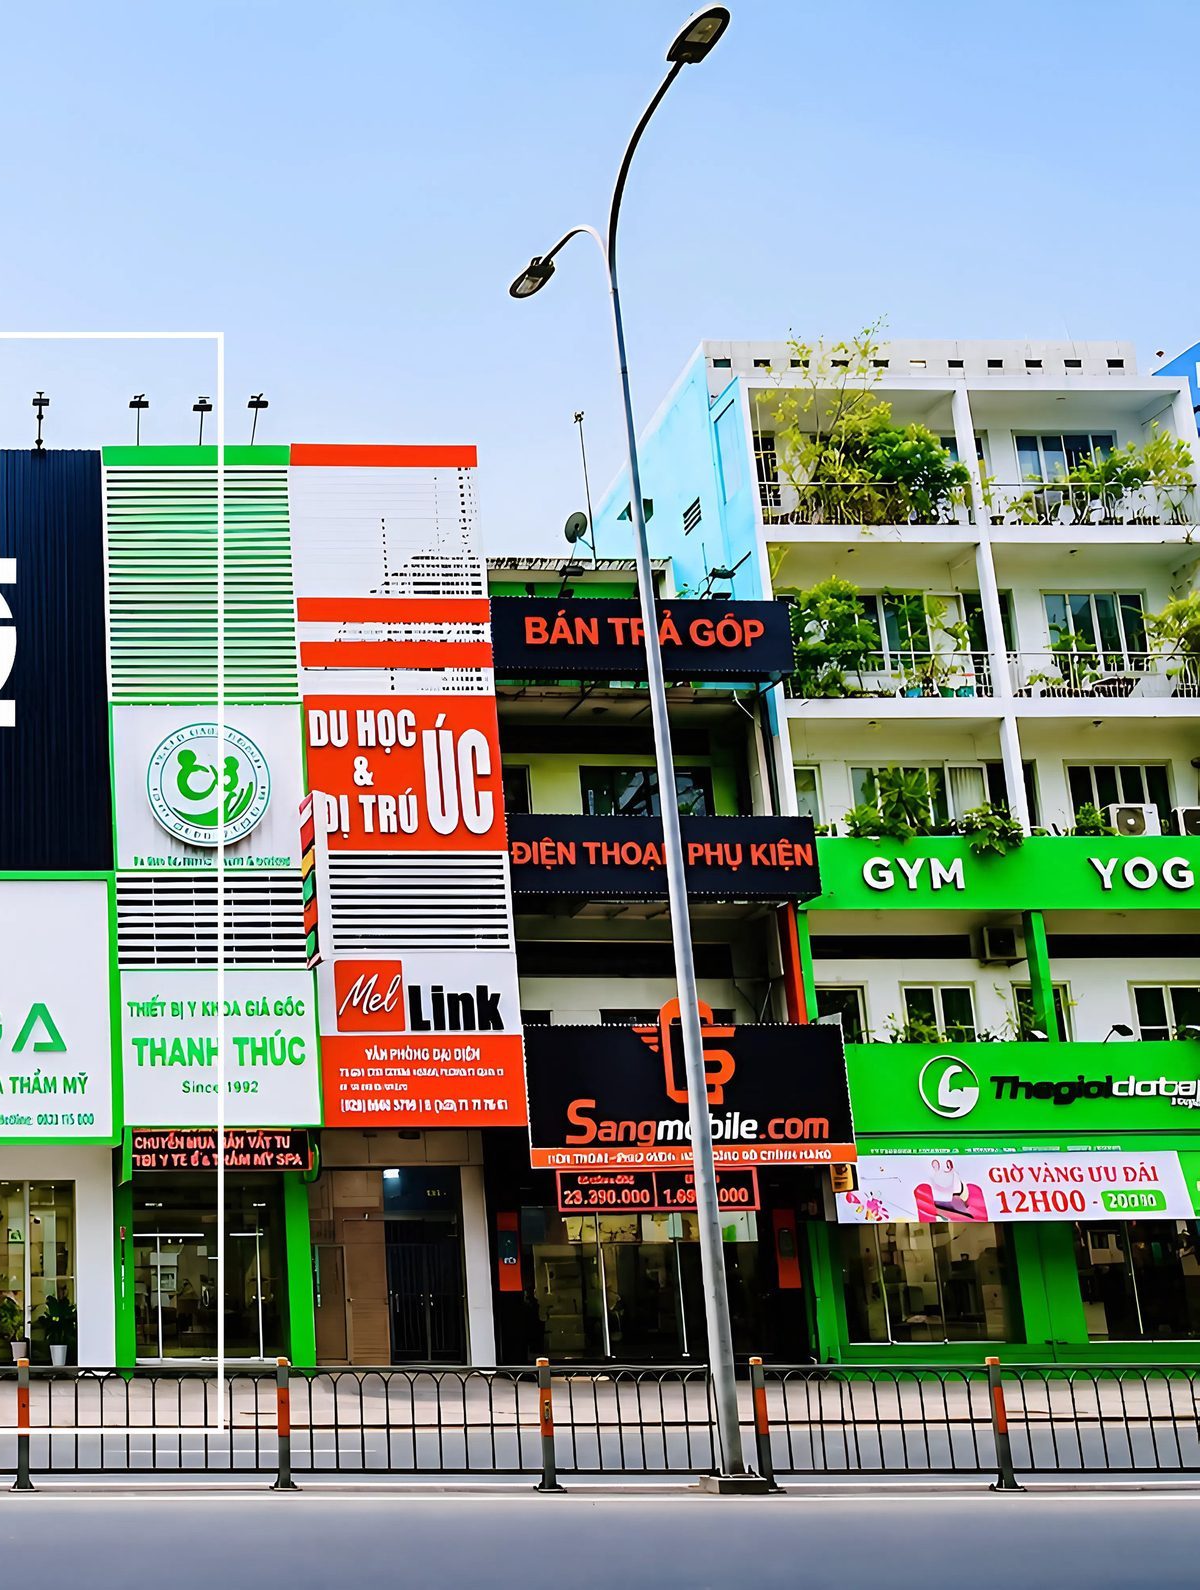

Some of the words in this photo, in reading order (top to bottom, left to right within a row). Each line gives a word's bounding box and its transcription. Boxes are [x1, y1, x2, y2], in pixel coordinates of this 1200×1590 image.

[524, 609, 599, 645] BÁN
[689, 612, 765, 648] GÓP
[308, 709, 349, 748] DU
[356, 708, 417, 755] HỌC
[352, 755, 375, 787] &
[421, 713, 495, 836] ÚC
[358, 787, 419, 835] TRÚ
[510, 836, 576, 871] ĐIỆN
[687, 842, 743, 872] PHỤ
[750, 838, 814, 872] KIỆN
[862, 856, 966, 891] GYM
[187, 1000, 197, 1018] Y
[407, 983, 506, 1032] Link
[131, 1036, 219, 1067] THANH
[232, 1028, 307, 1067] THÚC
[227, 1080, 260, 1094] 1992
[988, 1163, 1025, 1184] GIỜ
[1028, 1162, 1085, 1183] VÀNG
[995, 1189, 1087, 1214] 12H00
